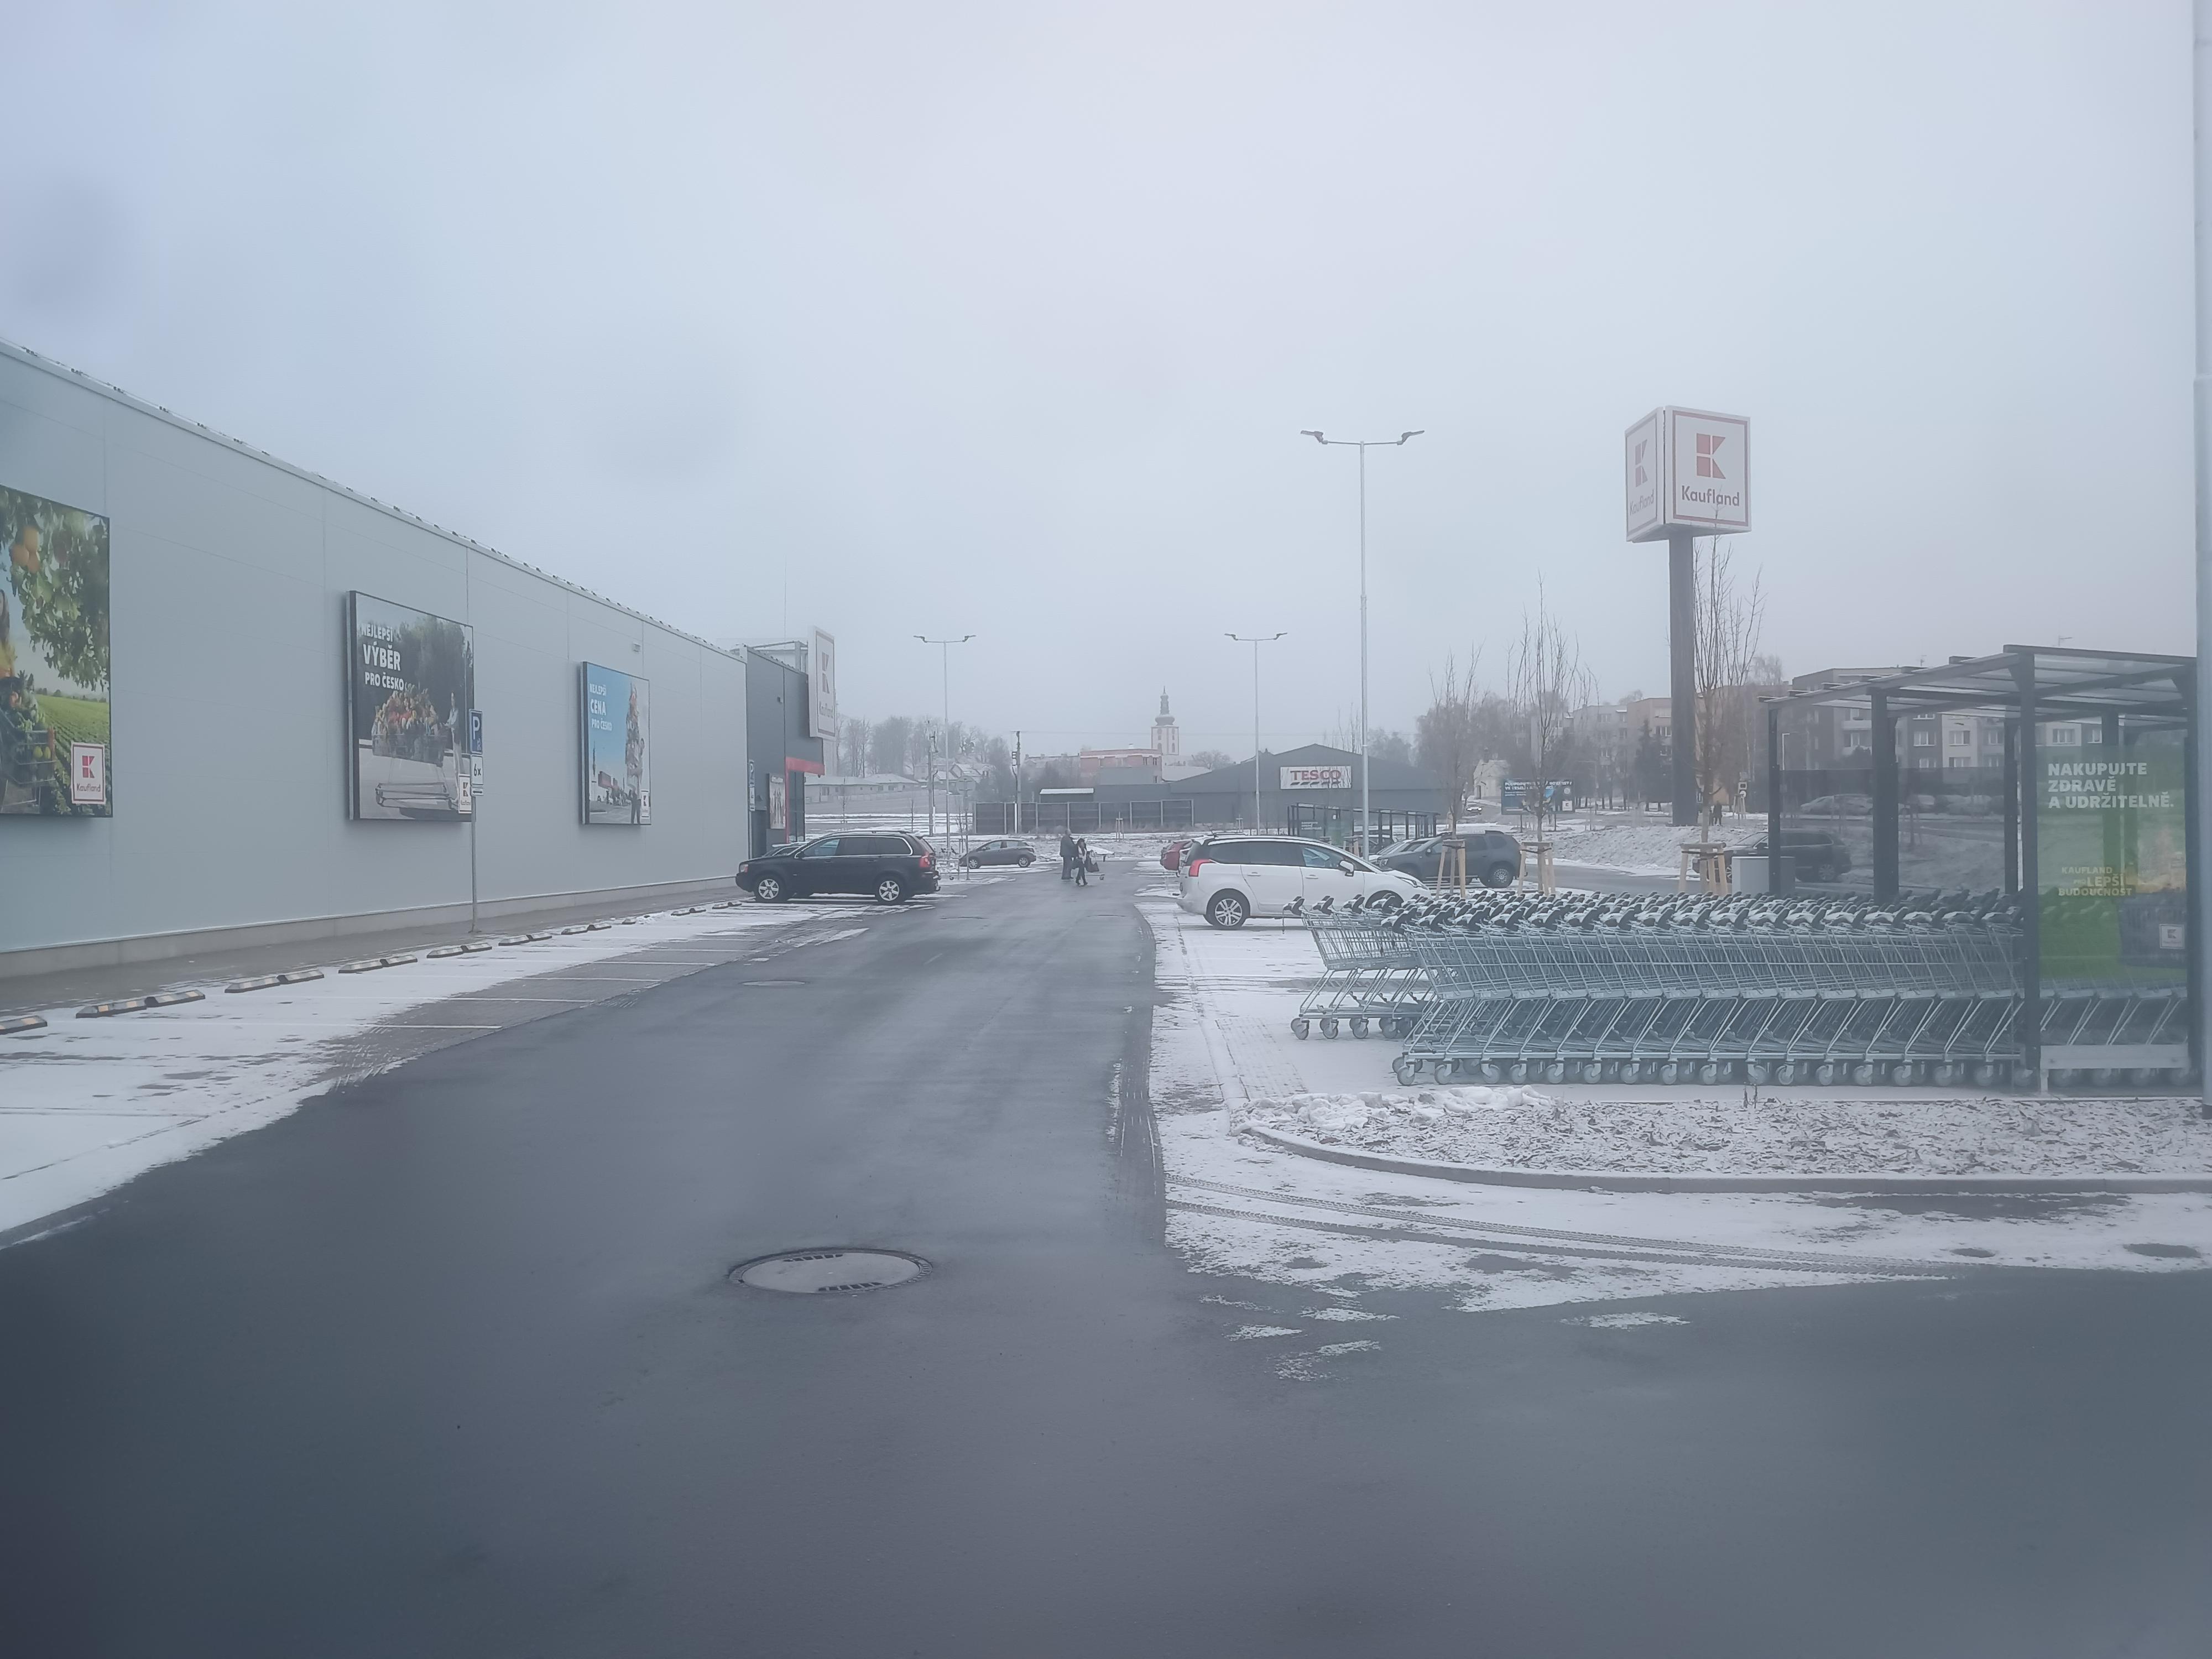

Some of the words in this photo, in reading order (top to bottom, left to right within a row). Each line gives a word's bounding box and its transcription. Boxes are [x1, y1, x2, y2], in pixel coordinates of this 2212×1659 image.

[1635, 439, 1648, 487] K
[1697, 433, 1726, 479] K
[1630, 489, 1654, 515] Kaufland
[1682, 486, 1739, 506] Kaufland
[362, 624, 393, 641] NEJLEPŠÍ
[363, 641, 401, 671] VÝBĚR
[365, 672, 380, 687] PRO
[382, 672, 404, 691] ČESKO
[590, 699, 606, 716] CENA
[473, 716, 480, 740] P
[82, 755, 95, 778] K
[473, 764, 481, 776] 6x
[1290, 770, 1342, 780] TESCO
[2048, 763, 2147, 776] NAKUPUJTE
[76, 783, 101, 792] Kaufland
[2048, 776, 2116, 792] ZDRAVĚ
[2048, 796, 2060, 808] A
[2065, 791, 2174, 808] UDRŽITELNĚ.
[2087, 873, 2124, 886] LEPŠÍ
[2058, 888, 2132, 896] BUDOUCNOST
